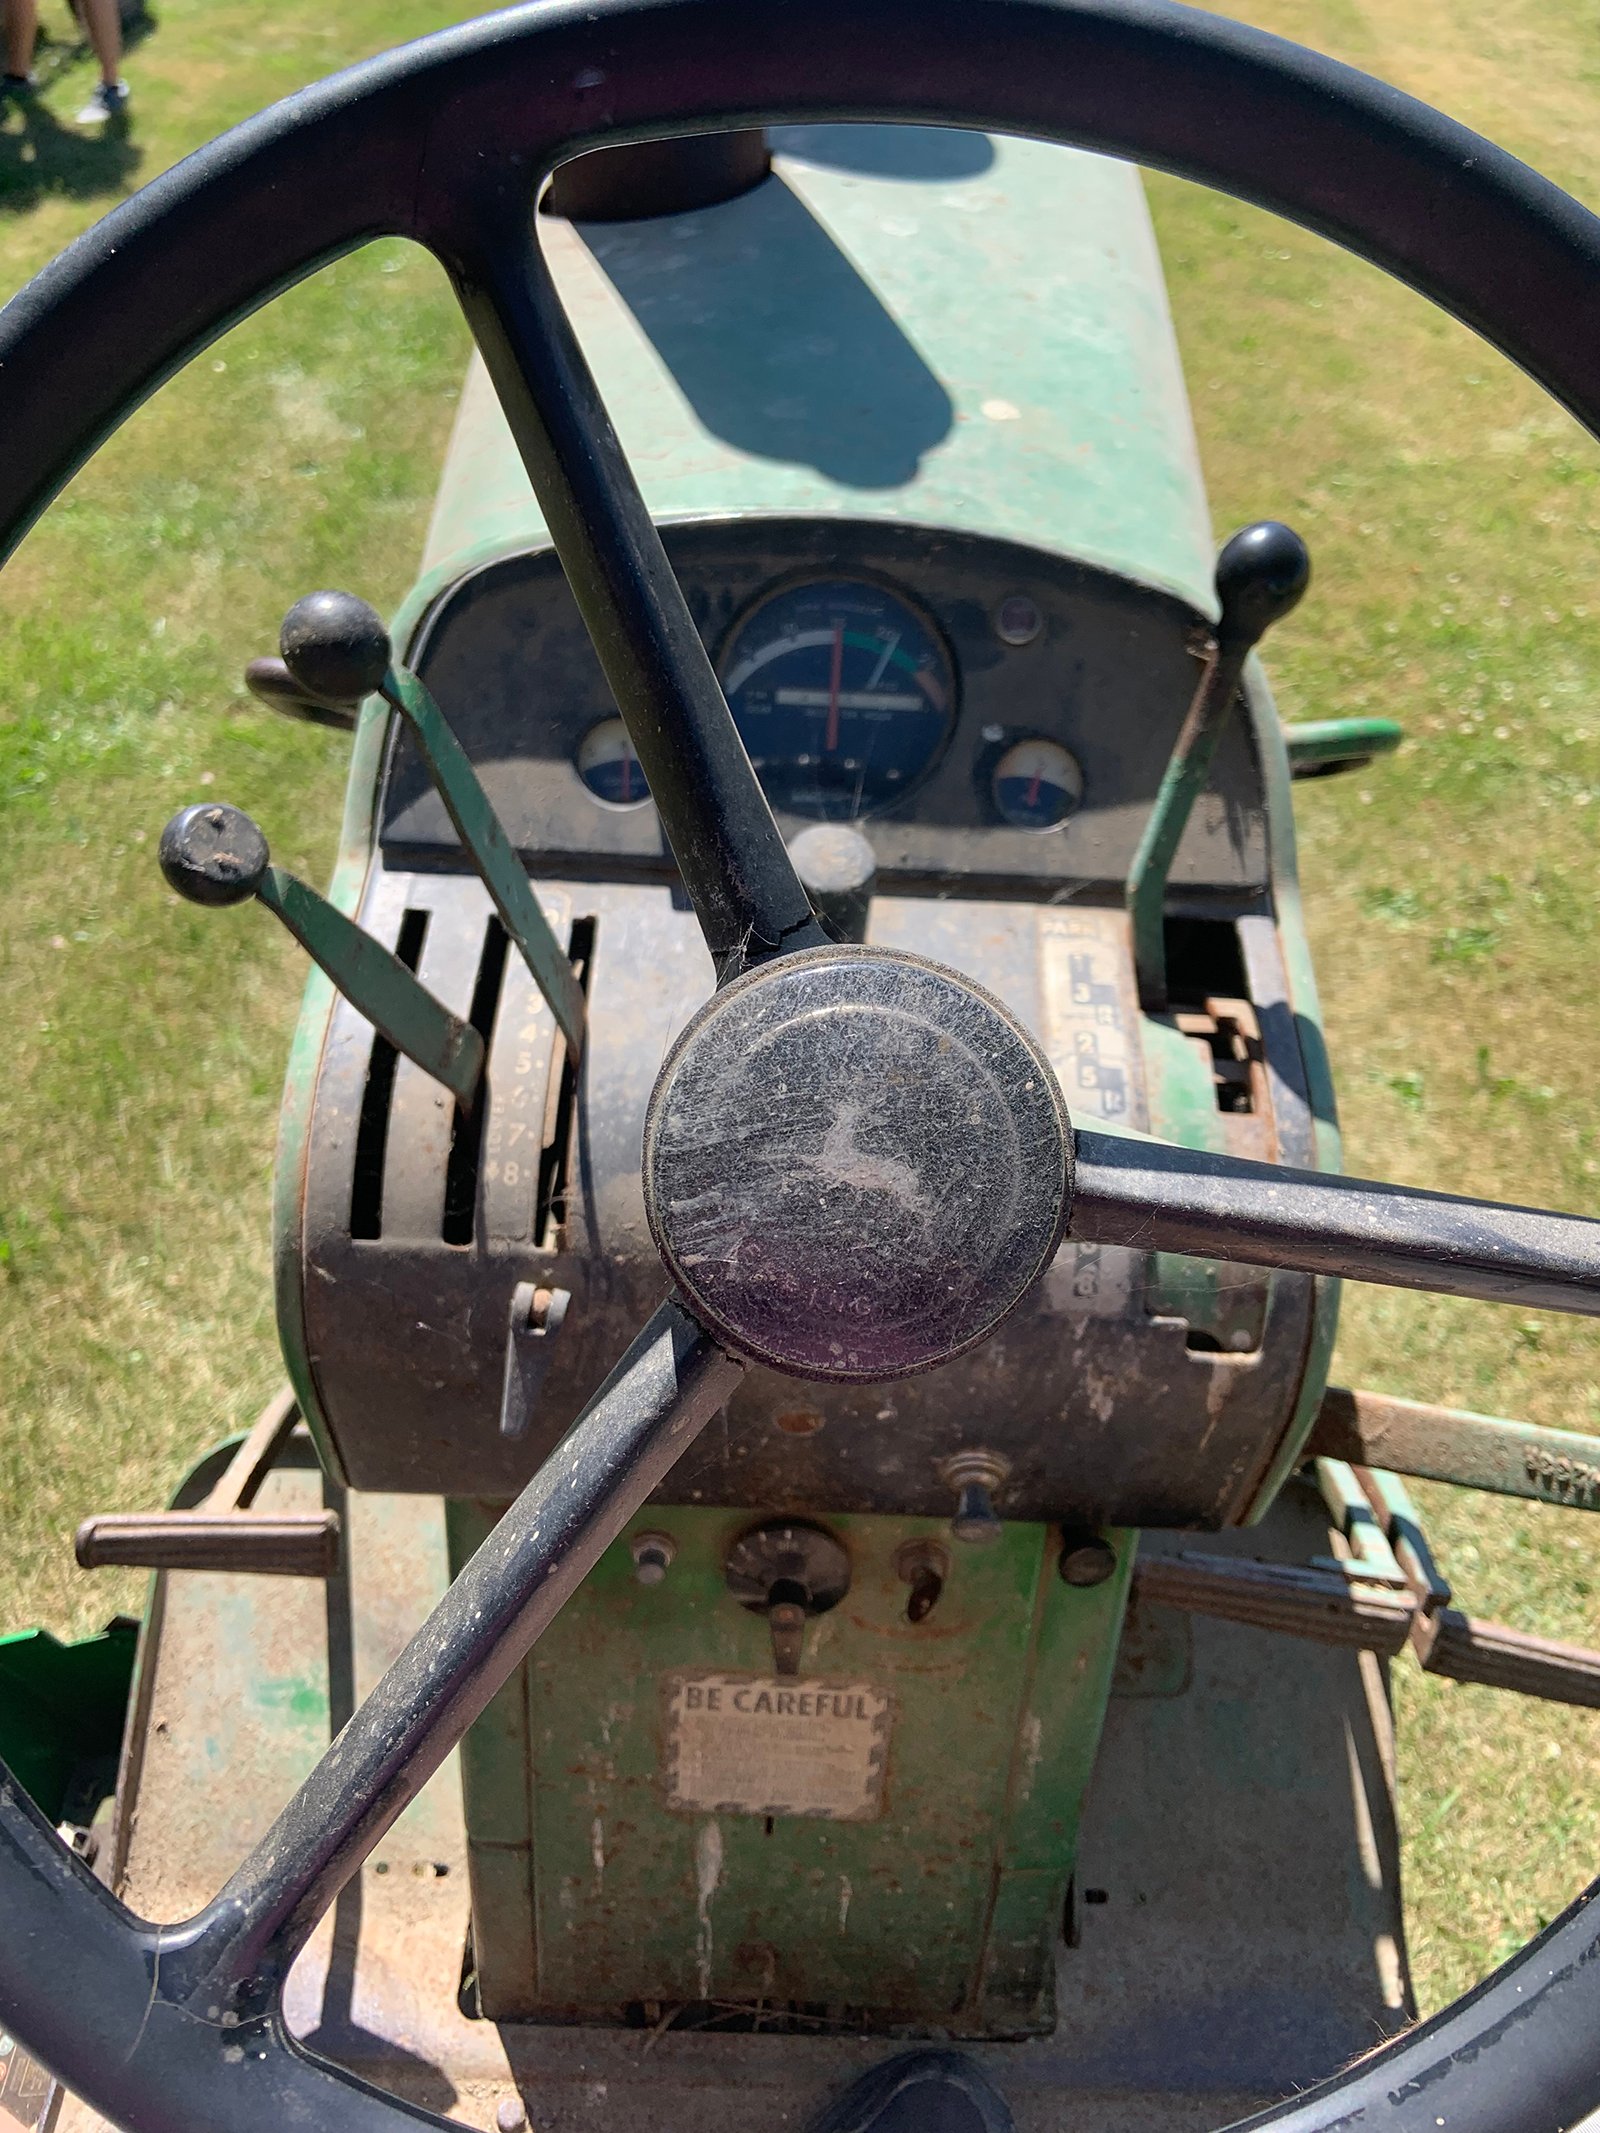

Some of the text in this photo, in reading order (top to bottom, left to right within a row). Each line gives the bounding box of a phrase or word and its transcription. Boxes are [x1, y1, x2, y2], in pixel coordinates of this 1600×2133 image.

[1074, 982, 1091, 1003] 3
[519, 1023, 537, 1043] 4
[1076, 1033, 1093, 1053] 2
[515, 1051, 531, 1075] 5
[1082, 1064, 1098, 1087] 5
[508, 1123, 527, 1146] 7
[503, 1161, 520, 1186] 8
[685, 1686, 871, 1721] BE CAREFUL
